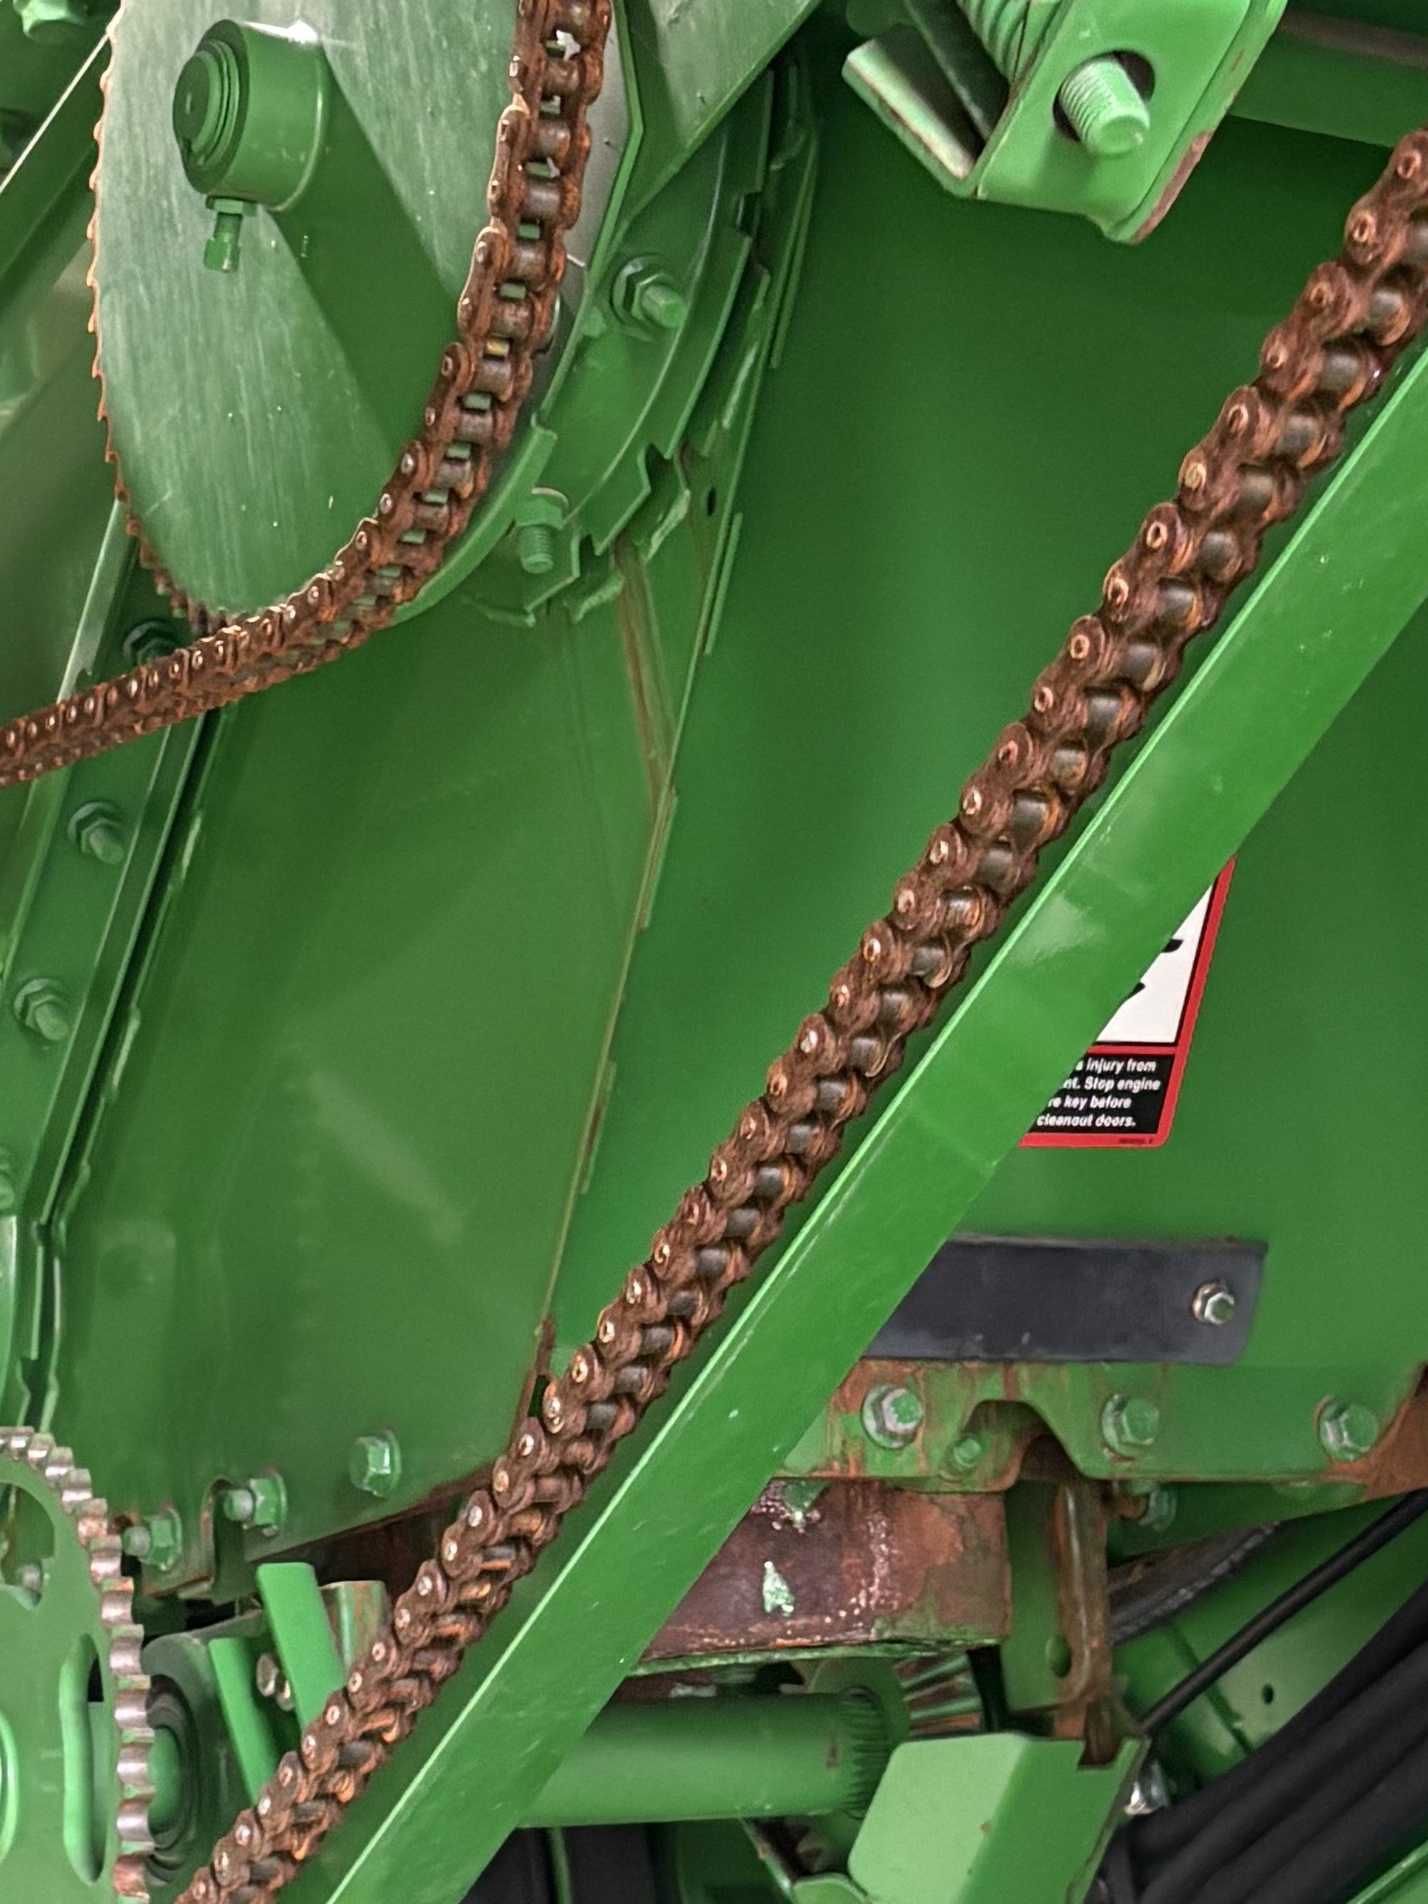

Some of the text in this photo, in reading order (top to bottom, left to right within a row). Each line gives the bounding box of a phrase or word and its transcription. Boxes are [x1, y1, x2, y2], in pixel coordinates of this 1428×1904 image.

[1086, 1057, 1125, 1075] injury
[1126, 1058, 1157, 1072] from
[1084, 1076, 1115, 1093] Stop
[1117, 1077, 1162, 1094] engine
[1063, 1095, 1088, 1111] key
[1090, 1095, 1132, 1109] before
[1036, 1113, 1137, 1128] cleanout doors.
